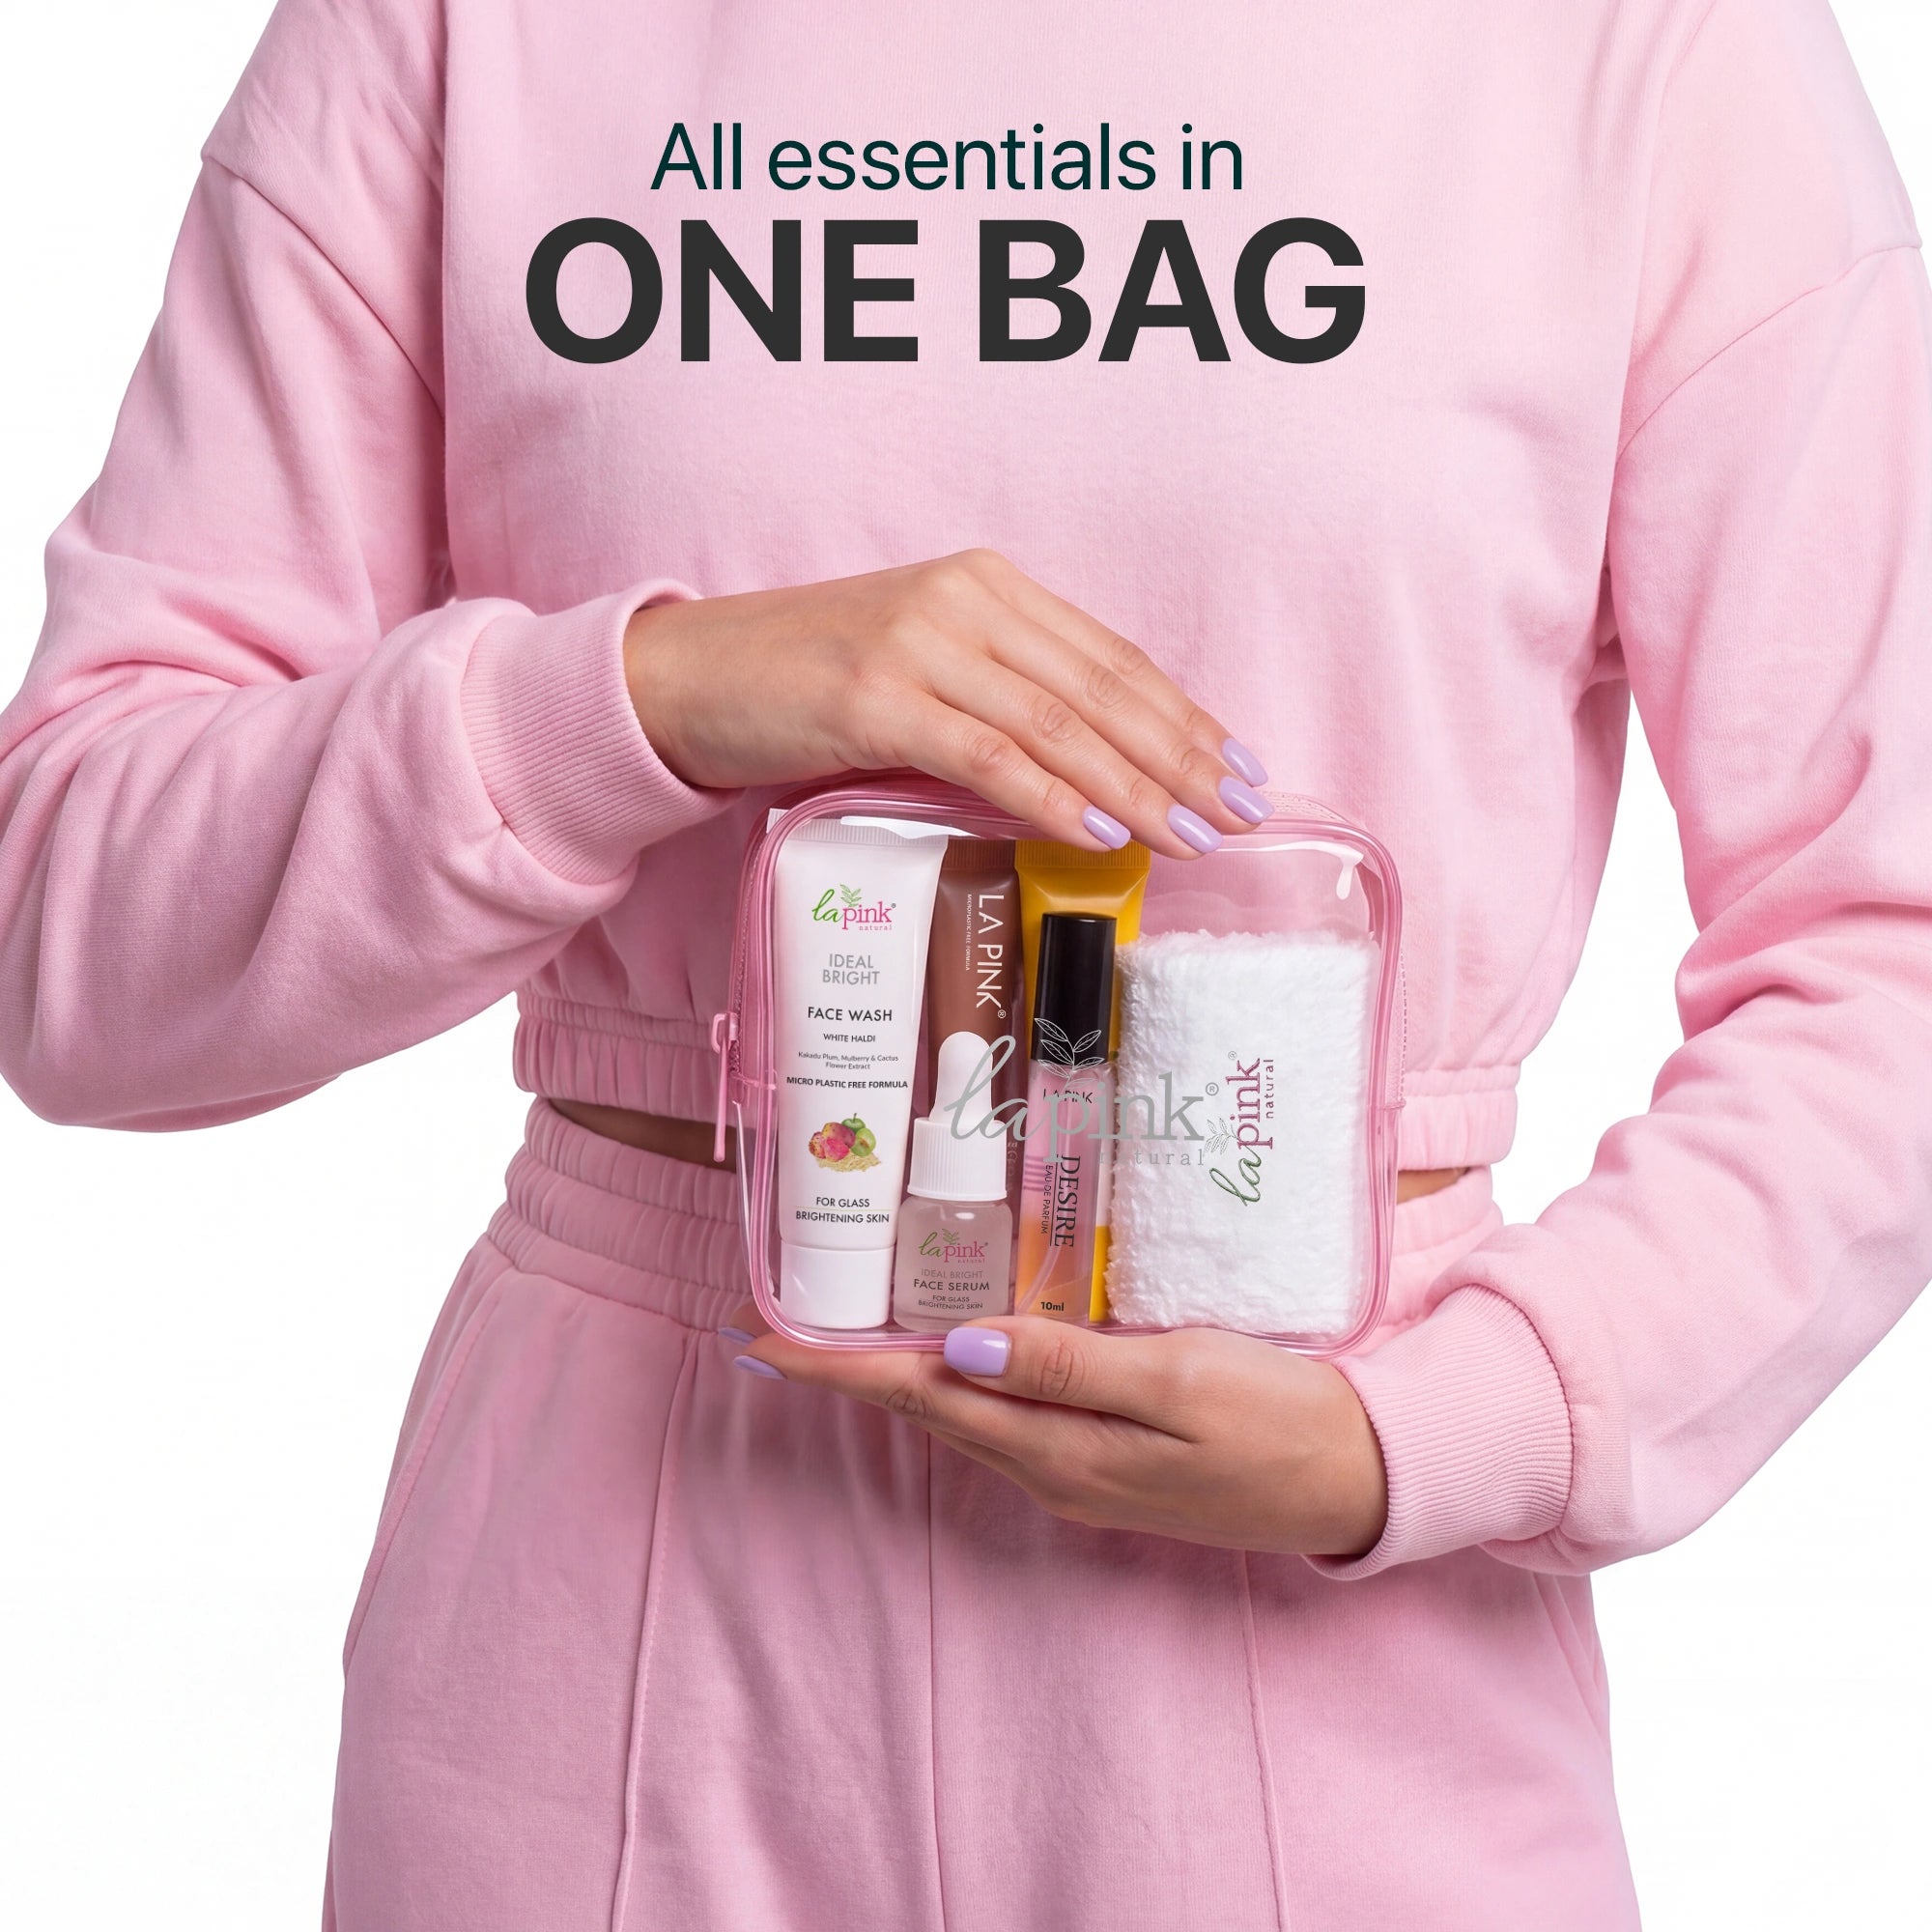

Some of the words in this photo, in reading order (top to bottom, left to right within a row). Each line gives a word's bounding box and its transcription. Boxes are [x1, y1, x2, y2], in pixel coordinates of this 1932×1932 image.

[978, 895, 1005, 934] LA
[829, 952, 874, 969] IDEAL
[822, 969, 880, 985] BRIGHT
[808, 1007, 843, 1021] FACE
[848, 1009, 893, 1022] WASH
[823, 1033, 849, 1042] WHITE
[851, 1035, 876, 1043] HALDI
[798, 1051, 821, 1060] Kakadu
[822, 1053, 840, 1062] Plum,
[840, 1054, 869, 1063] Mulberry
[825, 1062, 847, 1070] Flower
[786, 1076, 813, 1085] MICRO
[815, 1079, 846, 1089] PLASTIC
[868, 1080, 908, 1089] FORMULA
[1264, 1059, 1274, 1120] natural
[1044, 1164, 1053, 1182] EAU
[1043, 1184, 1052, 1197] DE
[815, 1196, 836, 1207] FOR
[838, 1198, 870, 1208] GLASS
[1054, 1154, 1080, 1248] DESIRE
[796, 1210, 864, 1223] BRIGHTENING
[866, 1213, 890, 1223] SKIN
[1040, 1199, 1051, 1235] PARFUM
[921, 1269, 948, 1278] IDEAL
[950, 1270, 983, 1279] BRIGHT
[913, 1278, 944, 1291] FACE
[948, 1282, 990, 1292] SERUM
[918, 1299, 965, 1310] BRIGHTENING
[1040, 1301, 1065, 1312] 10ml
